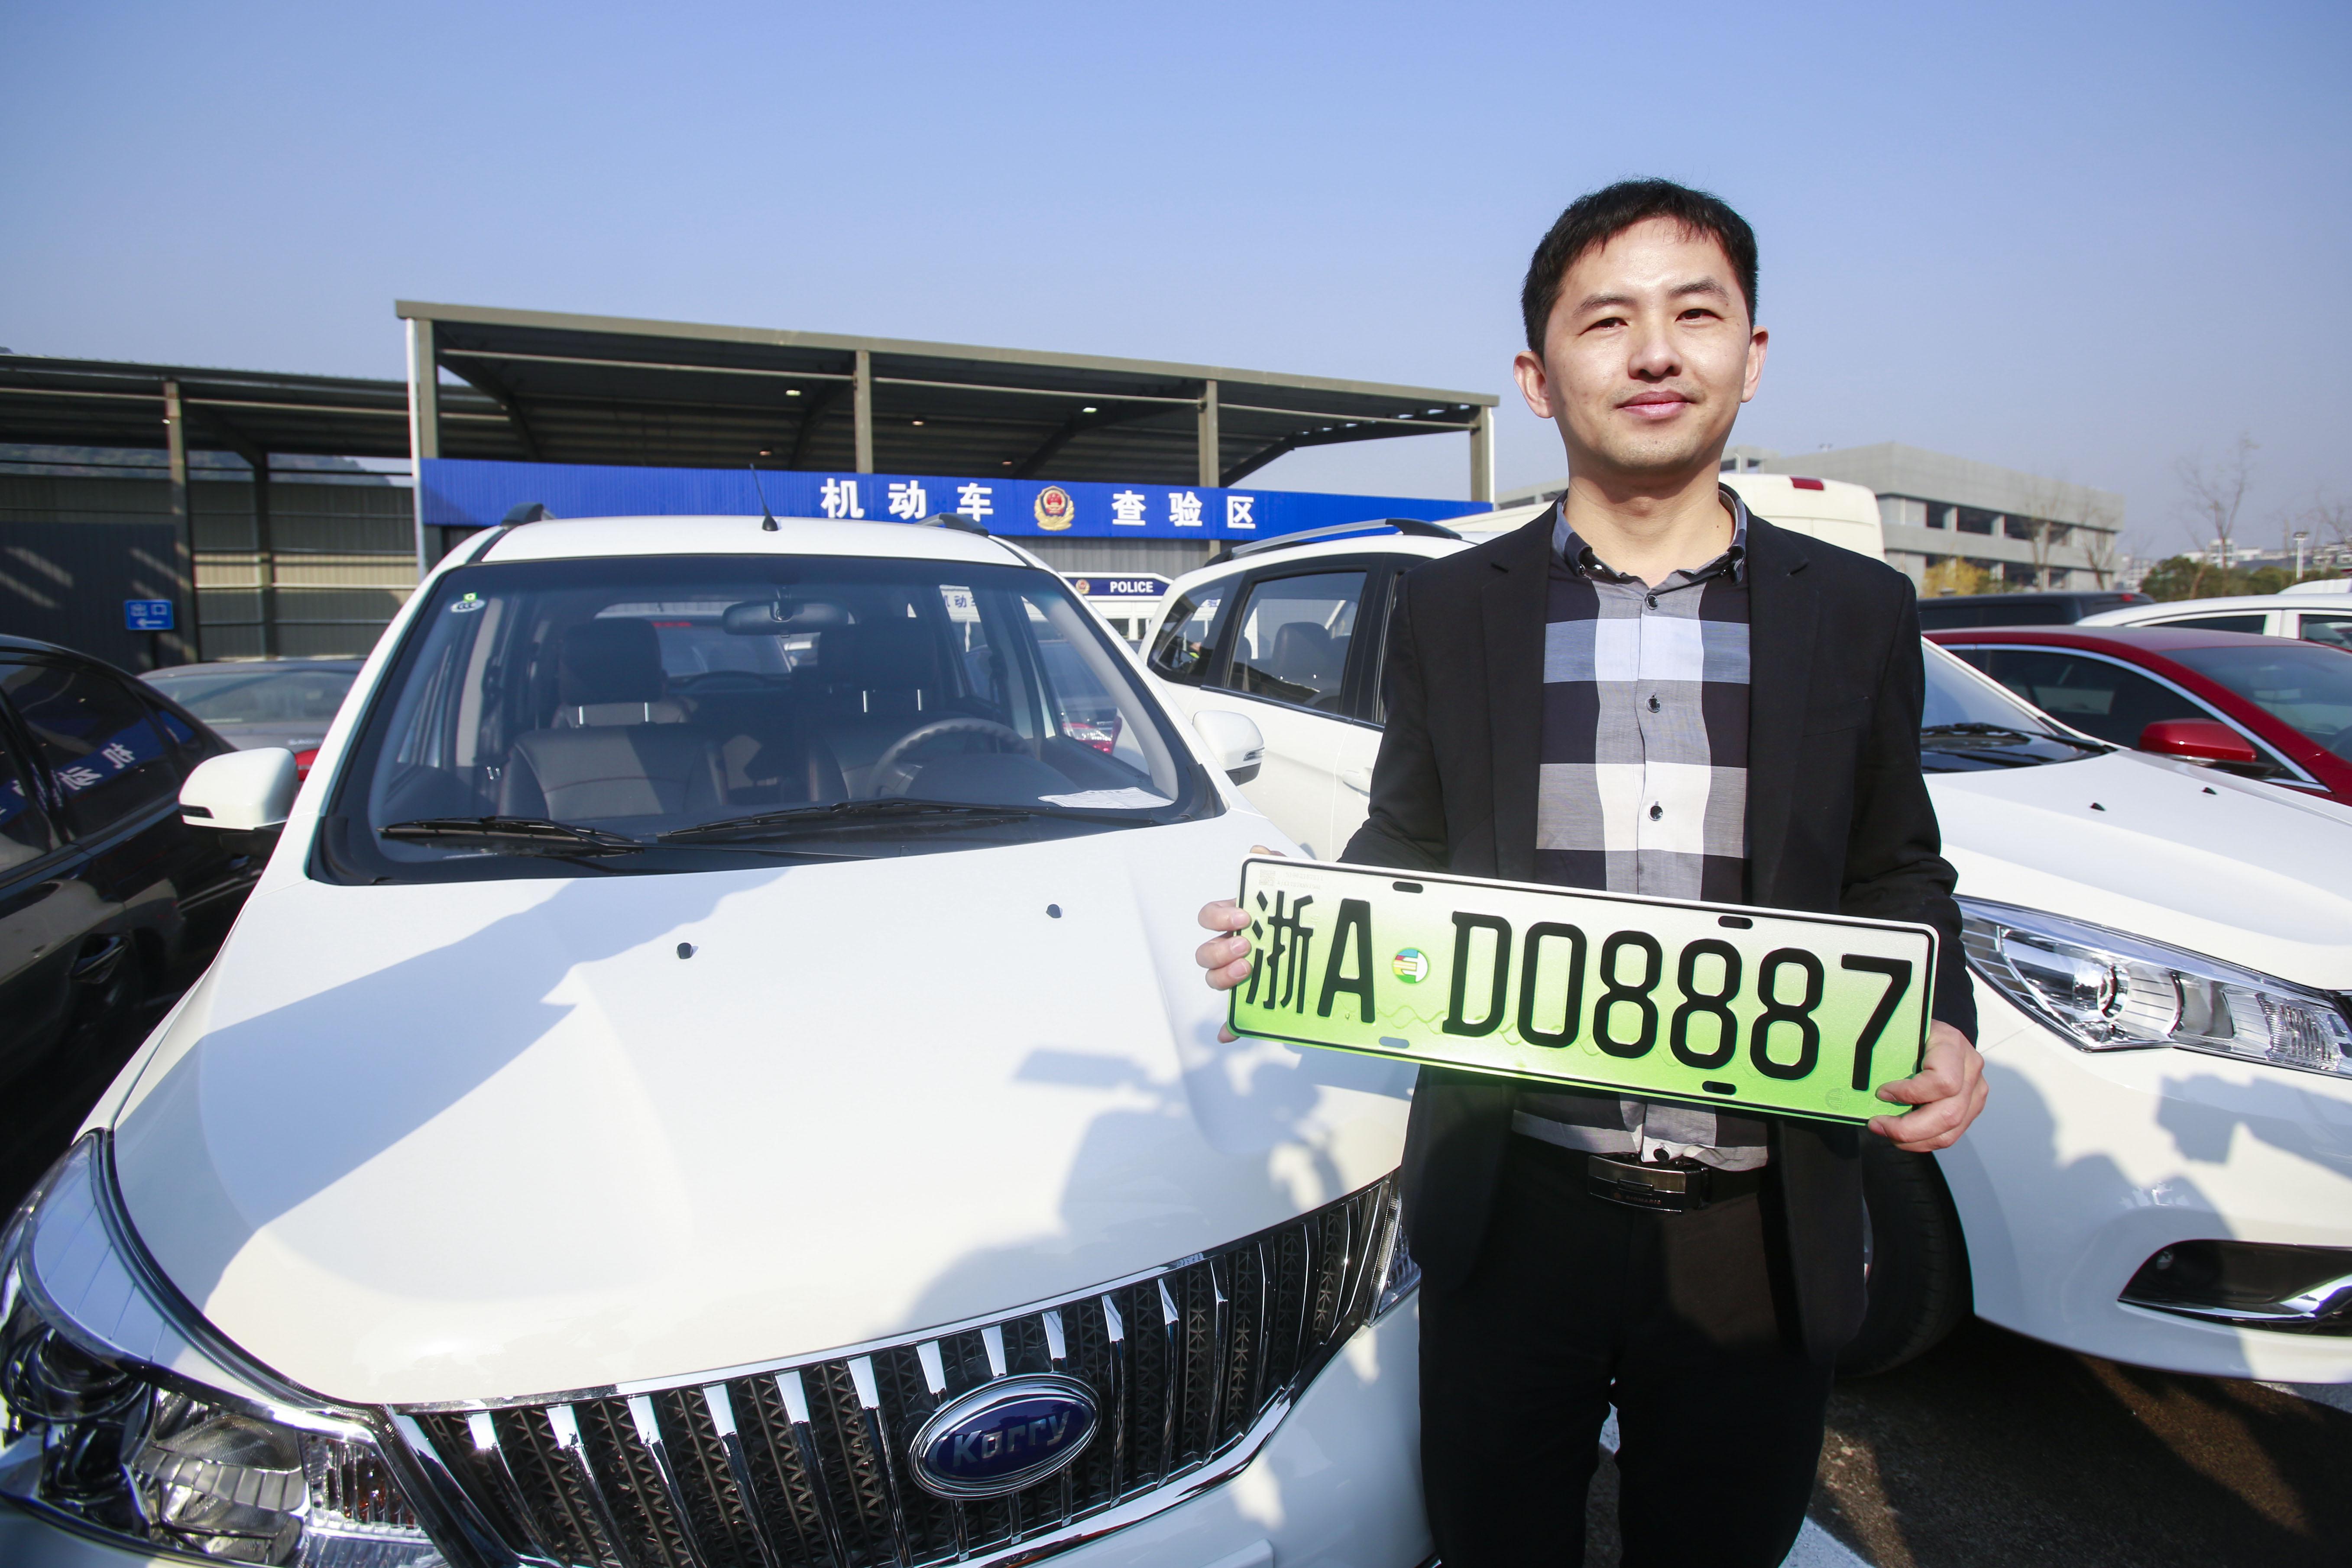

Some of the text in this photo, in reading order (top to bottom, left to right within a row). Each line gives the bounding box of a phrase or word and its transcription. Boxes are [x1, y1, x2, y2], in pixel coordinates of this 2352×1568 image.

[820, 477, 994, 521] 机动车
[1111, 489, 1256, 529] 查验区
[1110, 581, 1154, 593] POLICE
[1246, 890, 1911, 1092] 浙A D08887
